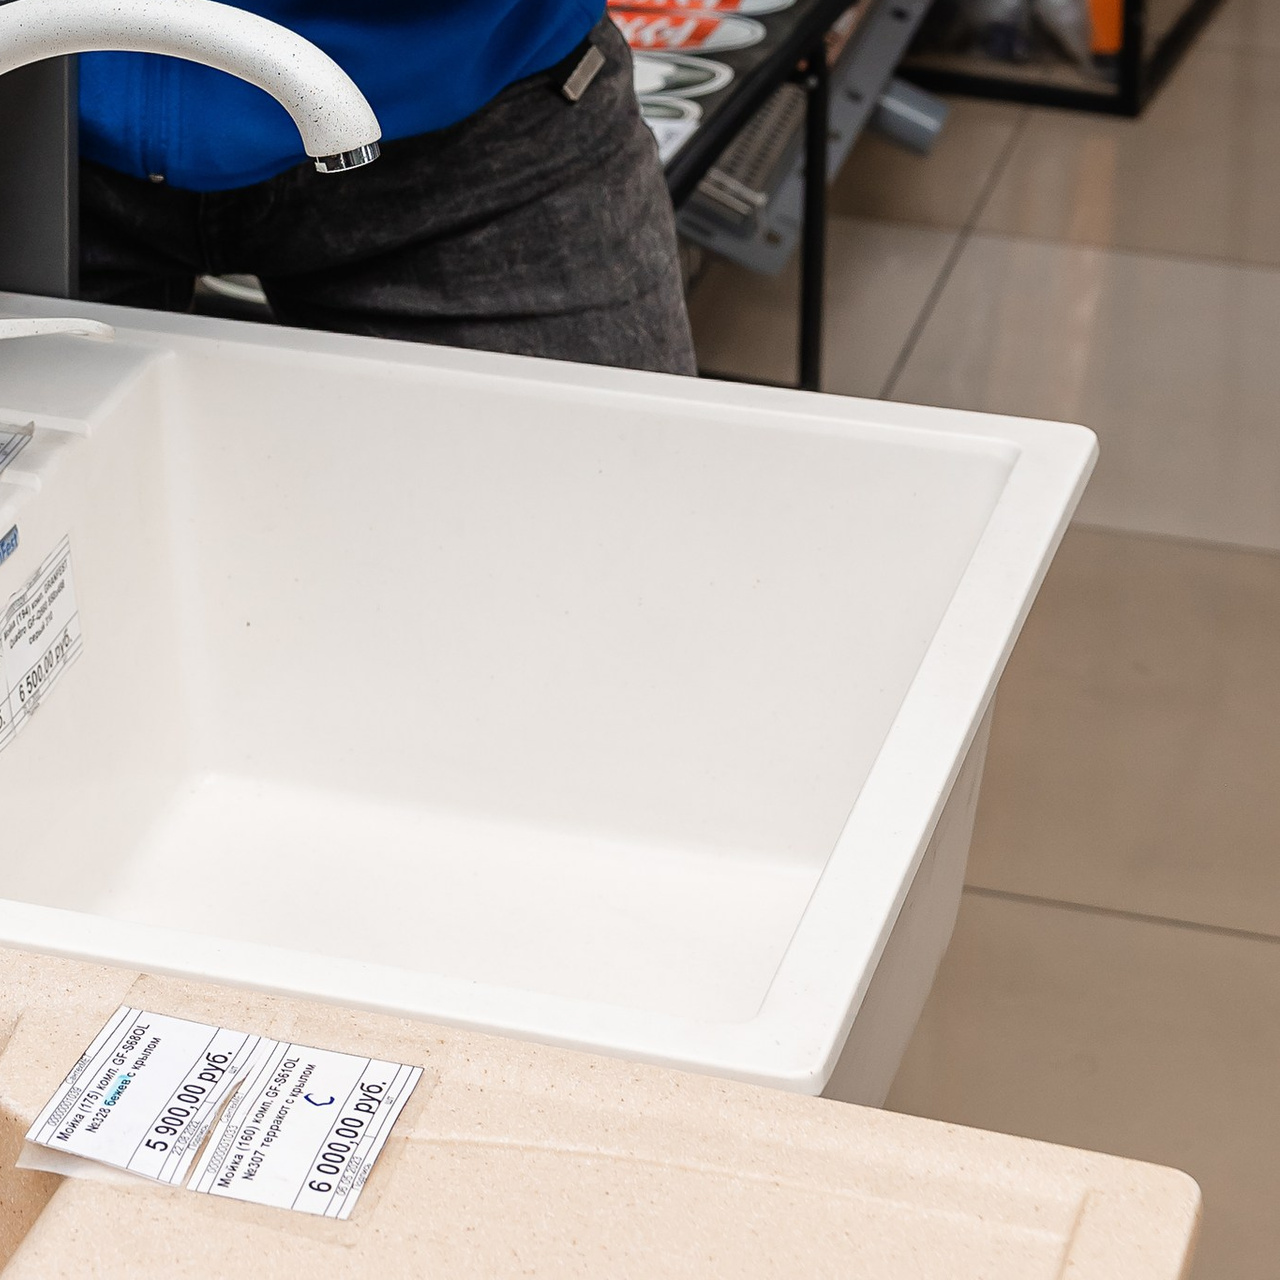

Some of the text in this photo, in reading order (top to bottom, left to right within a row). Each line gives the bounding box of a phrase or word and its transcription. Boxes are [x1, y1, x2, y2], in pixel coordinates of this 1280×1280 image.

[16, 604, 31, 626] (194)
[43, 559, 67, 594] GRANFEST
[9, 626, 27, 649] Quadro
[19, 684, 25, 702] 6
[26, 651, 54, 693] 500,00
[55, 628, 72, 663] руб.
[57, 1112, 85, 1142] Мойка
[78, 1090, 104, 1115] (175)
[97, 1067, 119, 1092] комп.
[85, 1107, 111, 1133] №328
[104, 1079, 131, 1107] бежев
[131, 1037, 162, 1071] крылом
[145, 1051, 233, 1152] 5 900,00 руб.
[242, 1151, 266, 1181] №307
[261, 1105, 291, 1149] терракот
[289, 1064, 317, 1099] крылом
[217, 1152, 244, 1188] Мойка
[237, 1125, 256, 1152] (160)
[252, 1099, 273, 1125] комп.
[308, 1082, 387, 1193] 6 000,00 руб.
